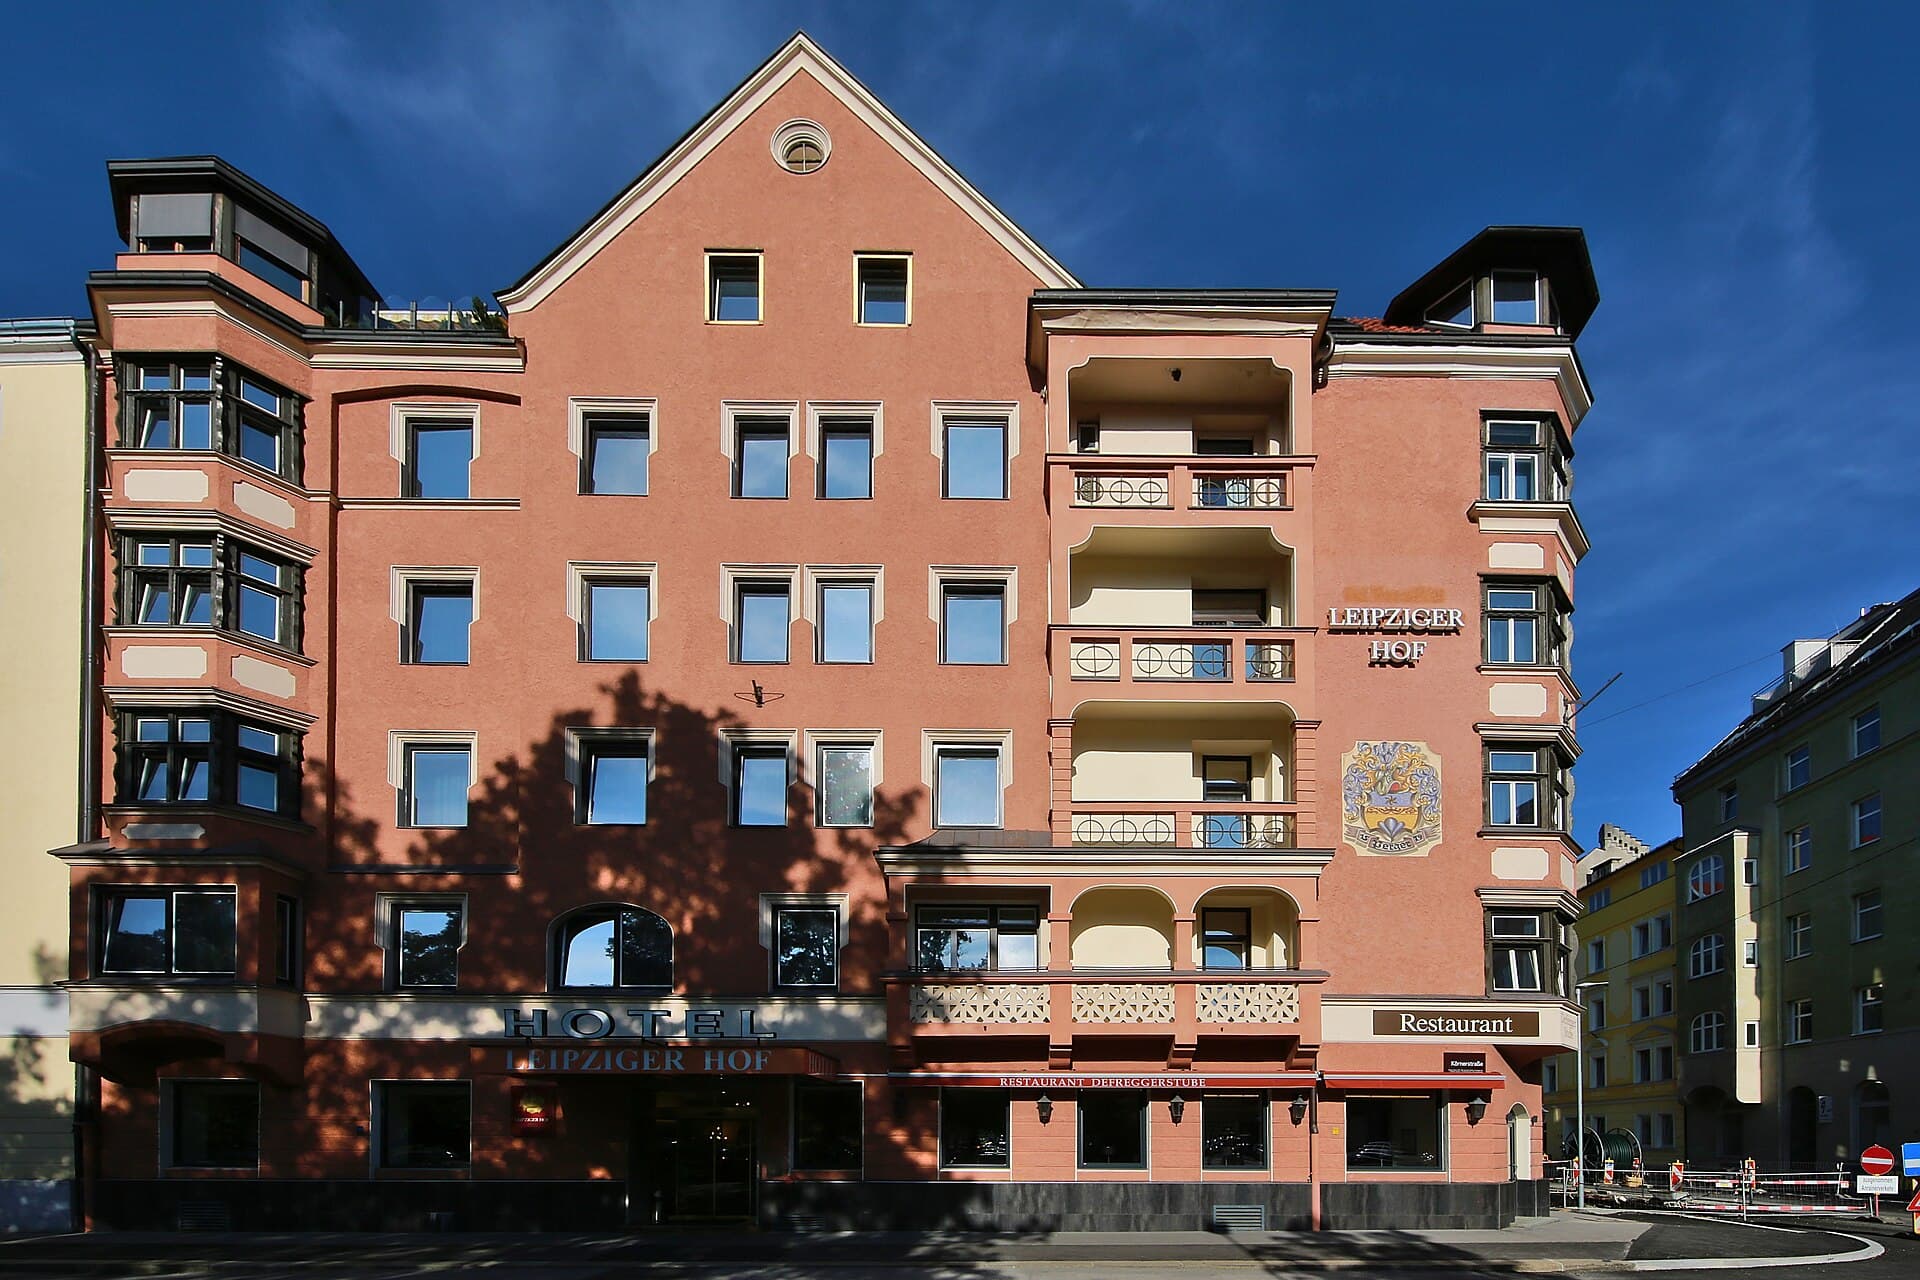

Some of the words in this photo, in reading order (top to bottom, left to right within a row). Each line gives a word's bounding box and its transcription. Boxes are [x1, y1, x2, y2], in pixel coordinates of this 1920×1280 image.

[1328, 607, 1465, 629] LEIPZIGER
[1370, 640, 1428, 661] HOF
[504, 1008, 777, 1039] HOTEL
[1400, 1013, 1513, 1033] Restaurant
[505, 1049, 685, 1072] LEIPZIGER
[704, 1049, 772, 1071] HOF
[1000, 1077, 1085, 1088] RESTAURANT
[1091, 1077, 1207, 1088] DEFREGGERSTUBE
